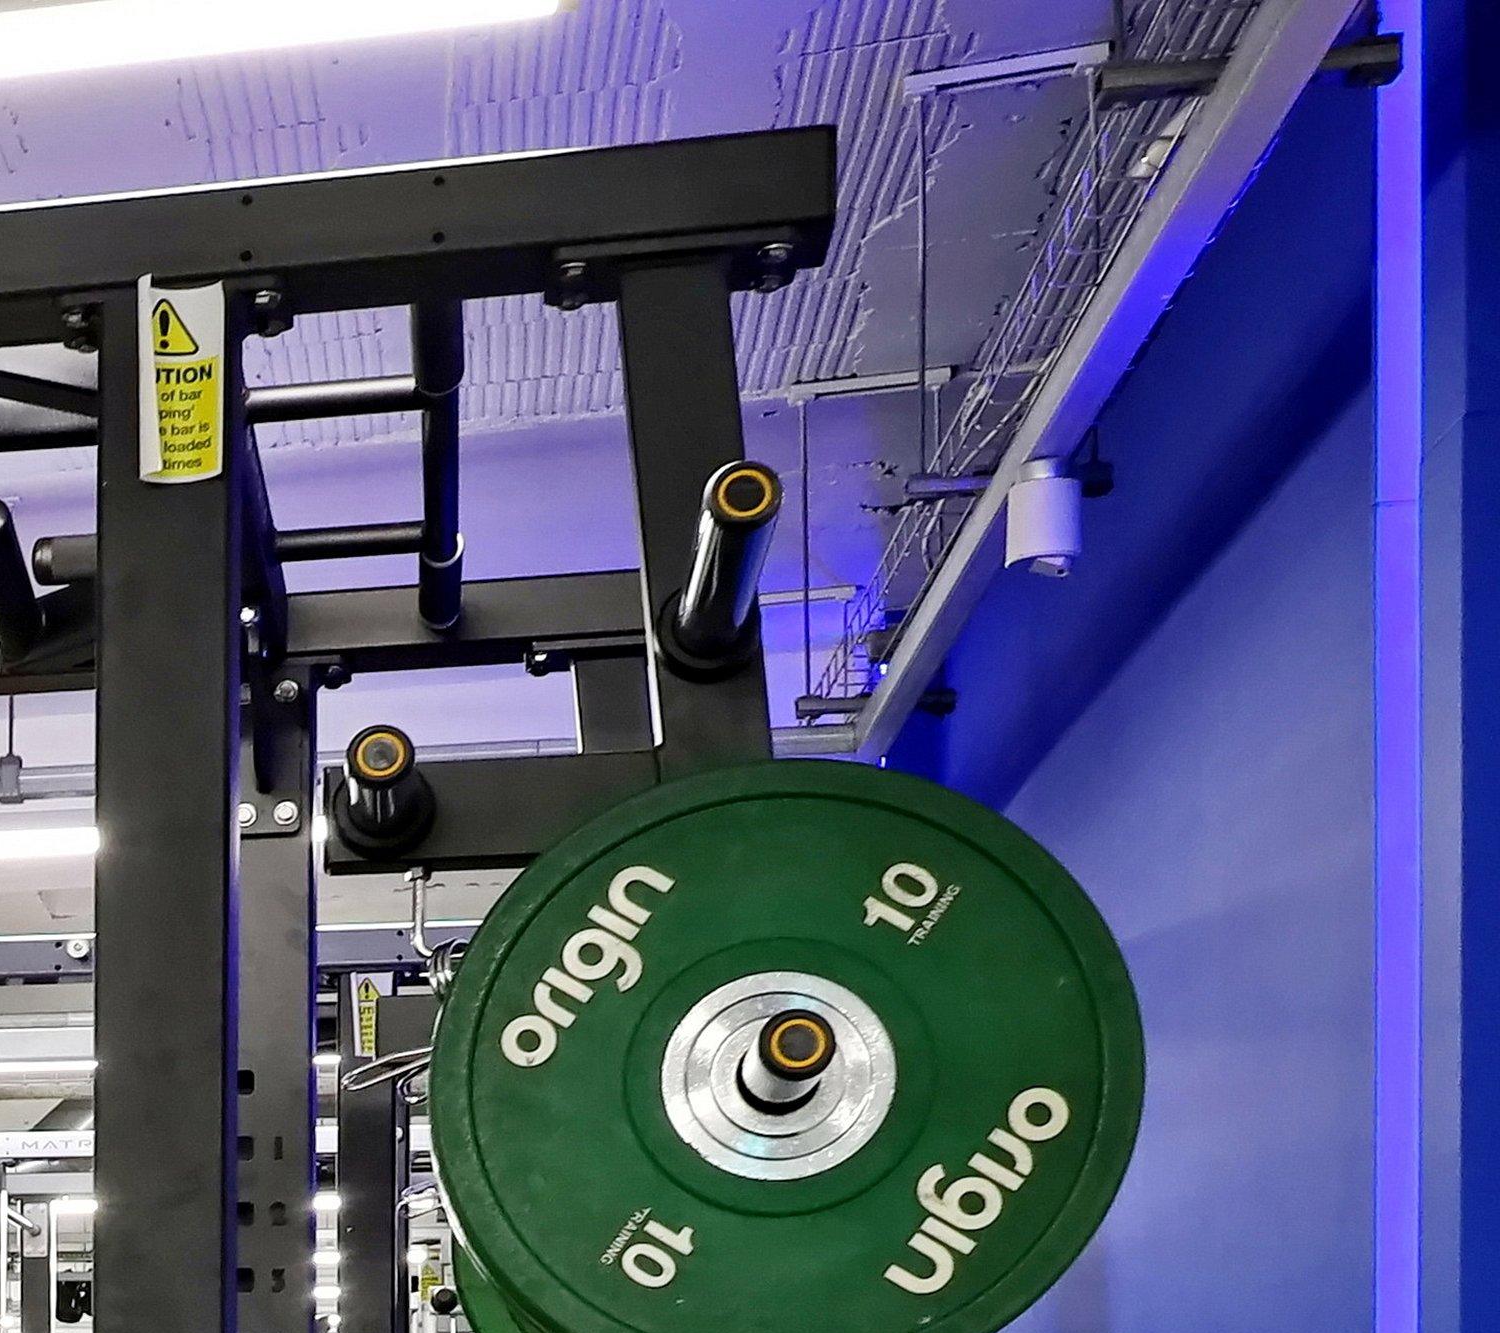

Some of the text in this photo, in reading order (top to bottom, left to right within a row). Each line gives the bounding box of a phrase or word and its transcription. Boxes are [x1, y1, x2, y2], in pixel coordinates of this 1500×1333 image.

[155, 363, 213, 385] TION
[161, 389, 203, 402] of bar
[171, 424, 194, 436] bar
[198, 421, 210, 433] is
[163, 437, 212, 453] loaded
[862, 862, 939, 932] 10
[907, 884, 962, 945] TRAINING
[501, 863, 676, 1069] origin
[21, 1140, 92, 1150] MATR
[274, 1136, 284, 1160] 1
[884, 1086, 1071, 1296] origin
[270, 1201, 287, 1226] 2
[599, 1207, 652, 1266] TRAINING
[621, 1220, 695, 1288] 10
[271, 1268, 285, 1293] 3
